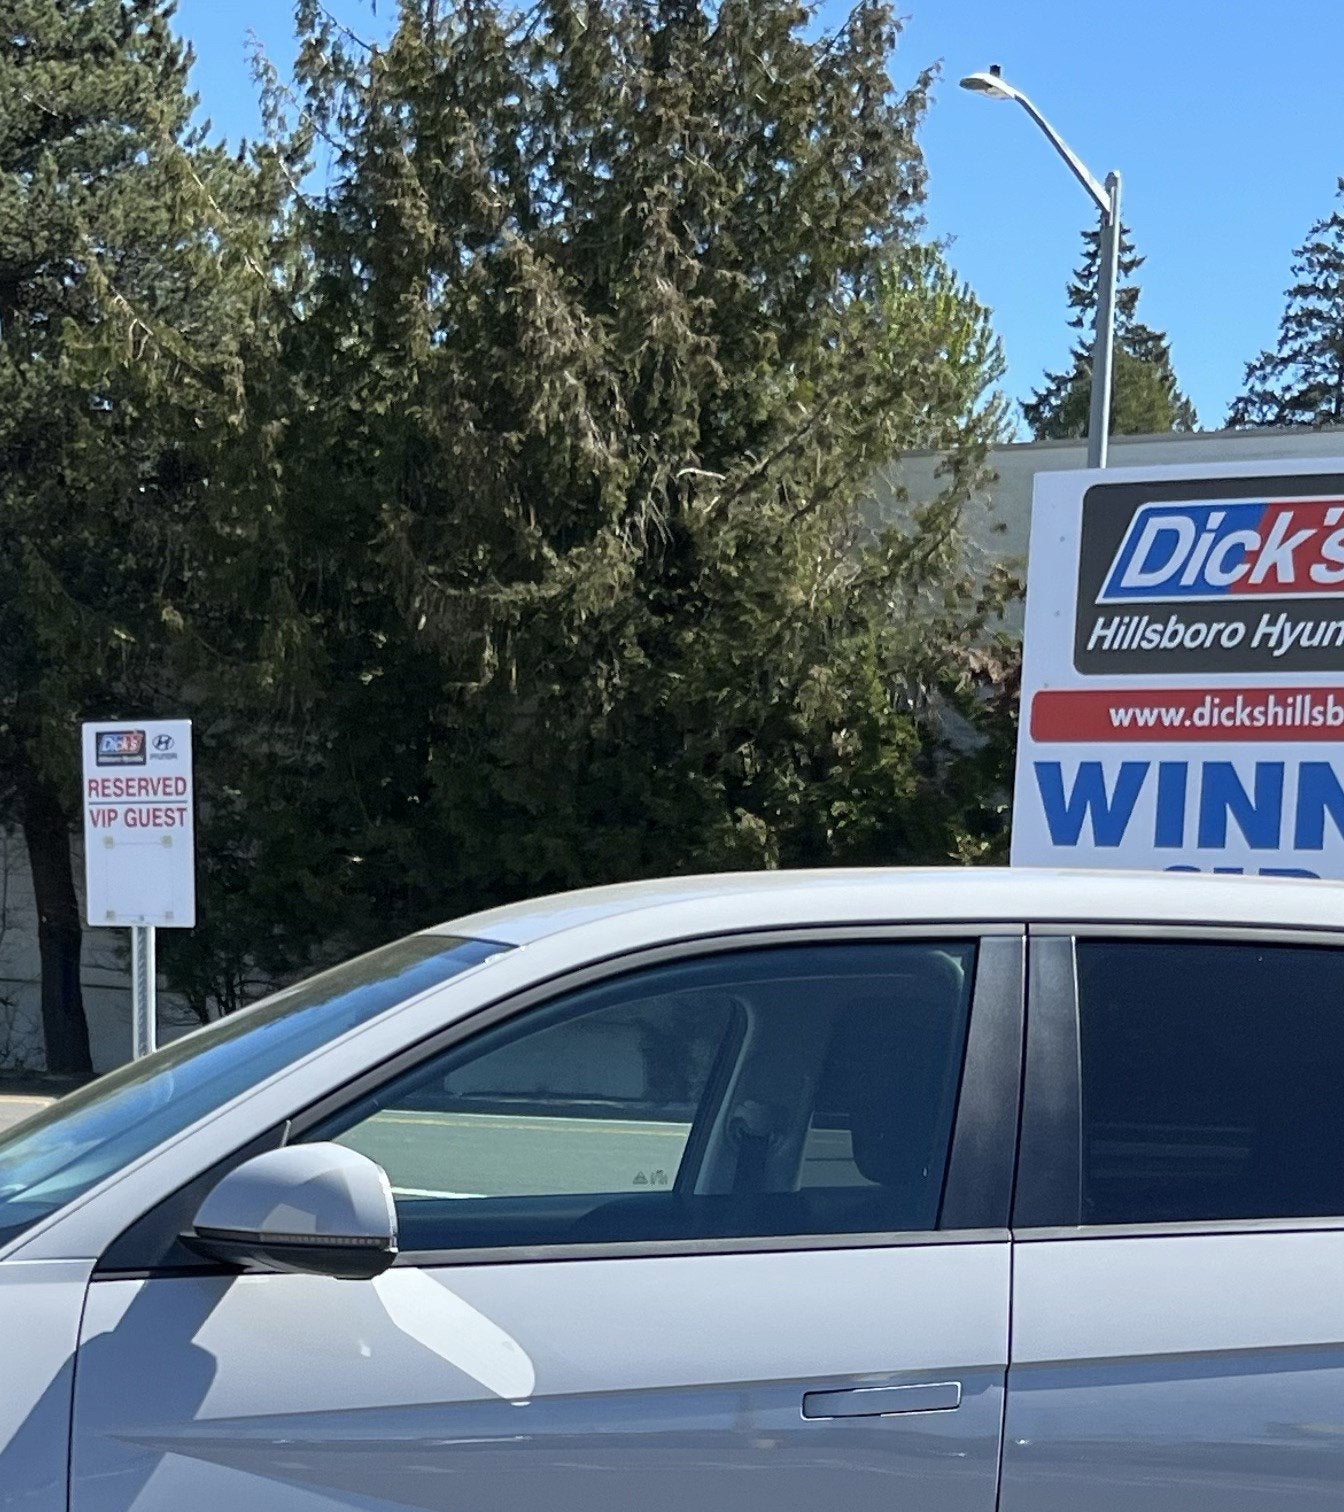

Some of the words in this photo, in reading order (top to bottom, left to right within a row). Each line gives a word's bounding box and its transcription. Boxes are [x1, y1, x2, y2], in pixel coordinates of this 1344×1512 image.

[1087, 613, 1246, 651] Hillsboro
[88, 776, 187, 798] RESERVED
[89, 808, 118, 828] VIP
[124, 807, 187, 828] GUEST
